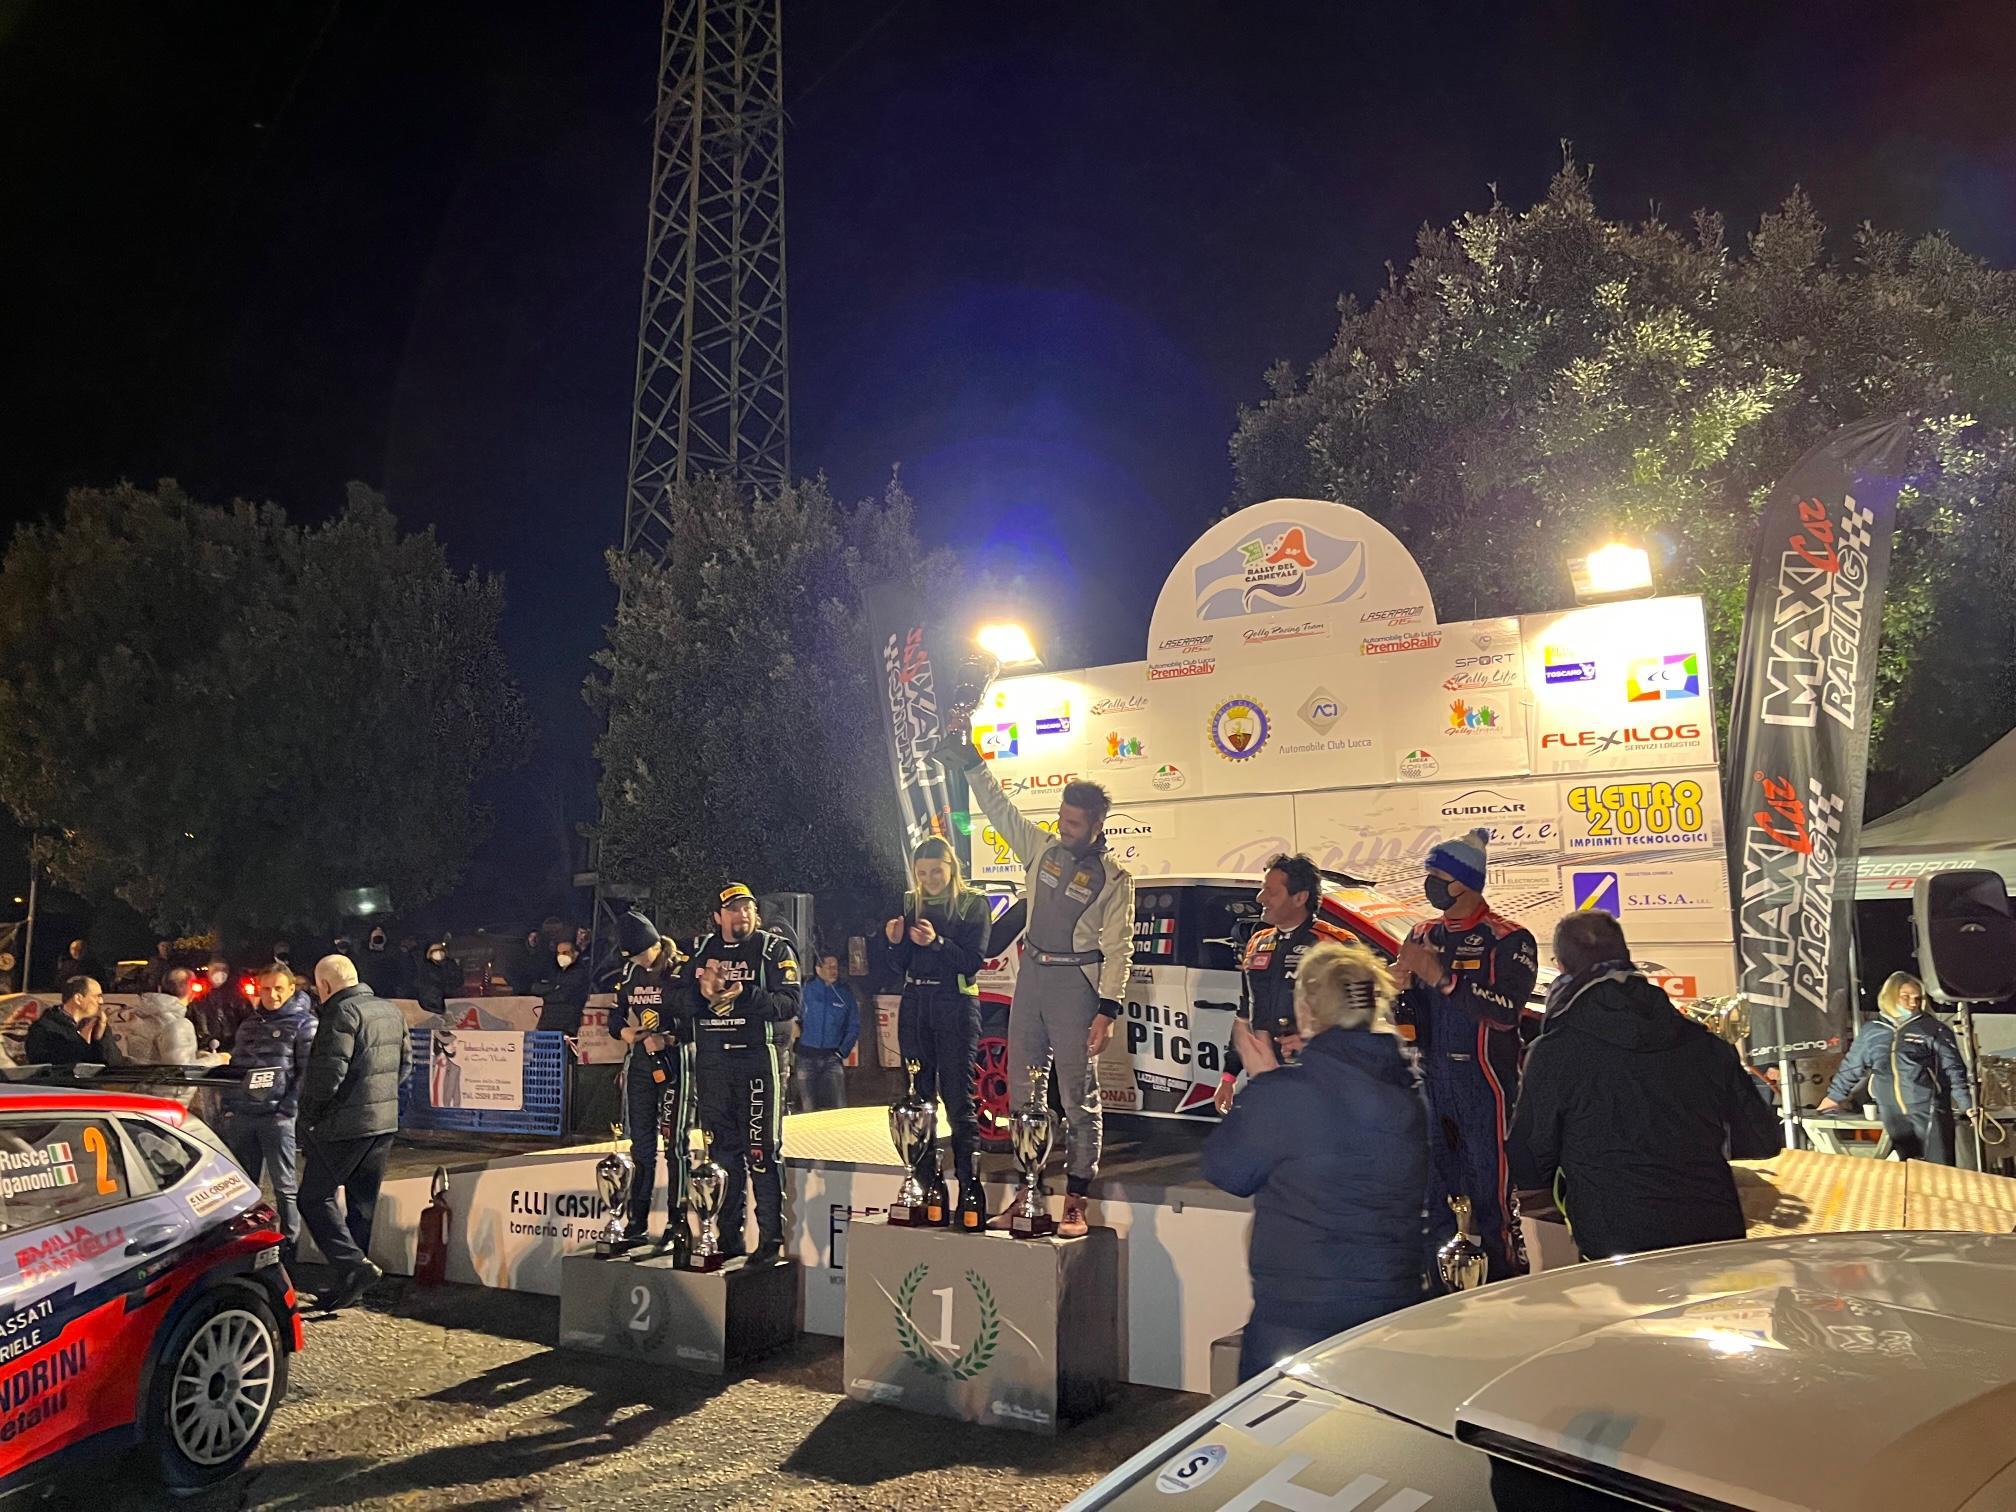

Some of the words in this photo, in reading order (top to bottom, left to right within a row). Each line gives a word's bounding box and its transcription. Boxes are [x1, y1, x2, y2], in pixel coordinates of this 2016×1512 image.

[1245, 570, 1298, 582] CARNEVALE
[1247, 566, 1275, 575] RALLY
[1360, 605, 1424, 621] LASERPROM
[1271, 625, 1300, 636] Racing
[1301, 622, 1324, 631] Team
[1363, 634, 1402, 644] Automobile
[1403, 631, 1420, 639] Club
[1421, 629, 1443, 637] Lucca
[1823, 545, 1869, 729] RACING
[1158, 634, 1214, 650] LASERPROM
[1366, 637, 1442, 655] PremioRally
[1762, 551, 1829, 728] MAXI
[1149, 659, 1182, 670] Automobile
[1183, 658, 1197, 666] Club
[1455, 653, 1516, 668] SPORT
[1151, 662, 1216, 680] PremioRally
[1454, 672, 1489, 688] Rally
[1312, 704, 1339, 719] ACI
[1279, 741, 1325, 754] Automobile
[1327, 740, 1346, 750] Club
[1347, 738, 1372, 748] Lucca
[1541, 724, 1700, 757] FLEXILOG
[1624, 742, 1659, 751] SERVIZI
[1659, 740, 1701, 750] LOGISTICI
[1001, 773, 1078, 798] EXILOG
[1568, 780, 1703, 812] ELETTRO
[1441, 804, 1526, 816] GUIDICAR
[1104, 826, 1152, 835] IDICAR
[1586, 806, 1704, 837] 2000
[1570, 836, 1622, 848] IMPIANTI
[1626, 833, 1708, 845] TECNOLOGICI
[1740, 826, 1807, 1008] MAXI
[1795, 837, 1837, 1012] RACING
[1100, 1090, 1136, 1103] ONAD
[750, 1079, 763, 1141] RACING
[0, 1149, 49, 1171] Rusce
[83, 1126, 118, 1195] 2
[510, 1190, 548, 1216] F.LLI
[555, 1194, 607, 1220] CASIP
[510, 1221, 558, 1238] torneria
[562, 1223, 574, 1238] di
[577, 1229, 606, 1244] prec
[627, 1286, 652, 1332] 2
[932, 1287, 960, 1350] 1
[1176, 1456, 1209, 1479] S
